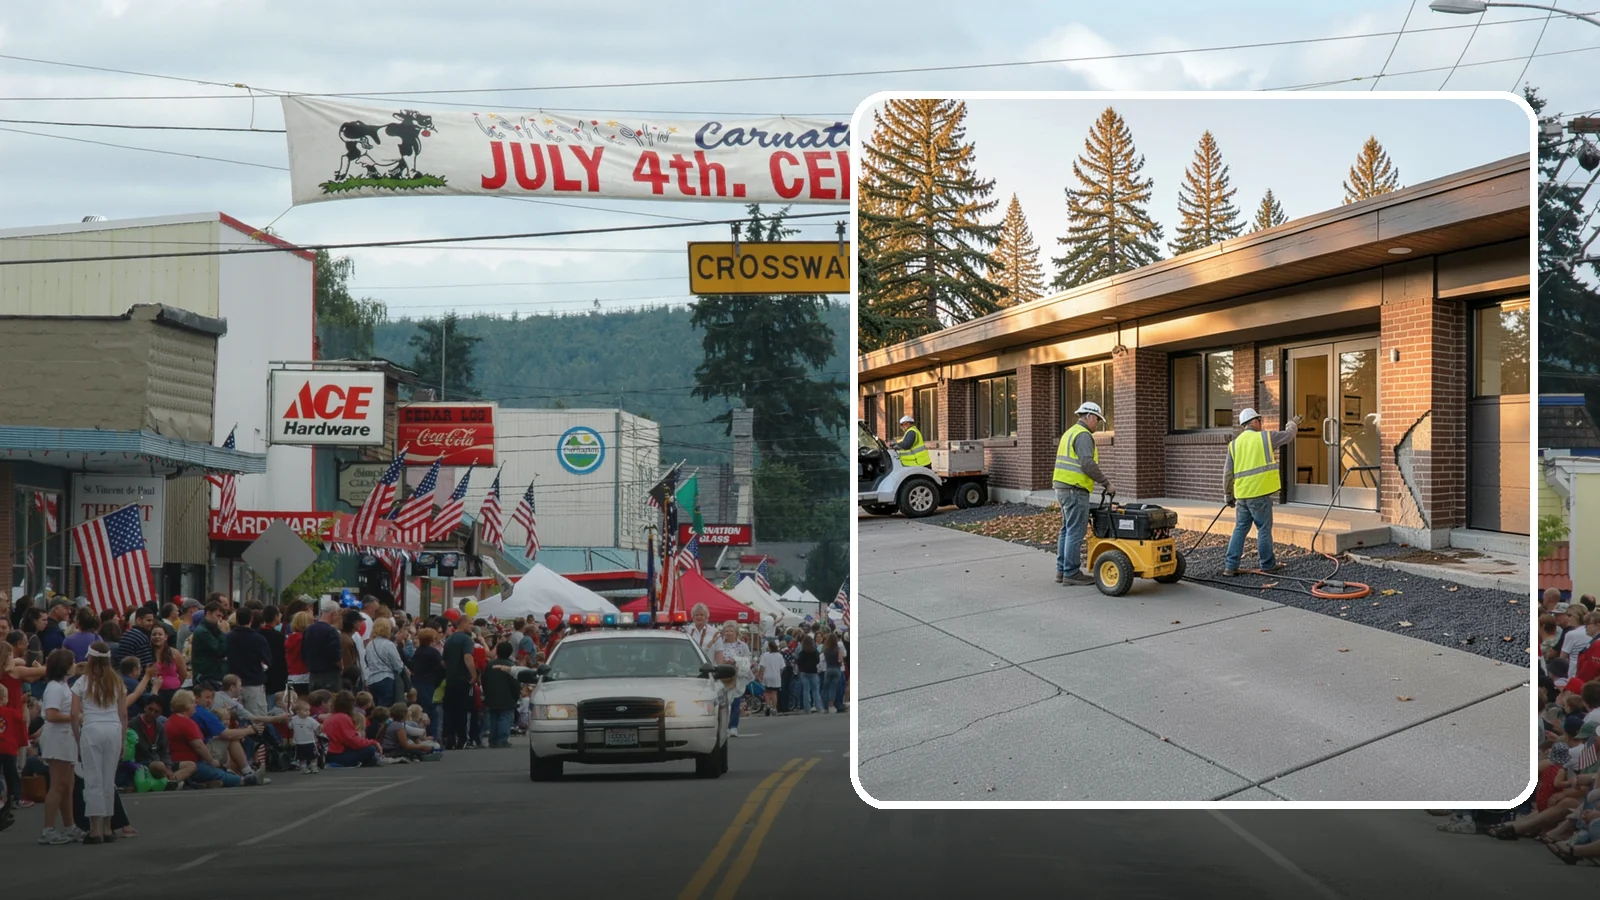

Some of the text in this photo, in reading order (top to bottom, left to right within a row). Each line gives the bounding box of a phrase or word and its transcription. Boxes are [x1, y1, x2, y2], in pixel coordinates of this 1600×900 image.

[695, 121, 850, 150] Carnat
[481, 141, 605, 192] JULY
[632, 149, 746, 198] 4th.
[697, 254, 850, 280] CROSSWA
[283, 380, 374, 420] ACE
[405, 409, 485, 422] CEDAR LOG
[283, 421, 371, 436] Hardware
[96, 485, 124, 494] Vincent
[126, 486, 135, 494] de
[137, 486, 155, 495] Paul
[688, 526, 741, 535] CRNATION
[699, 535, 730, 543] GLASS
